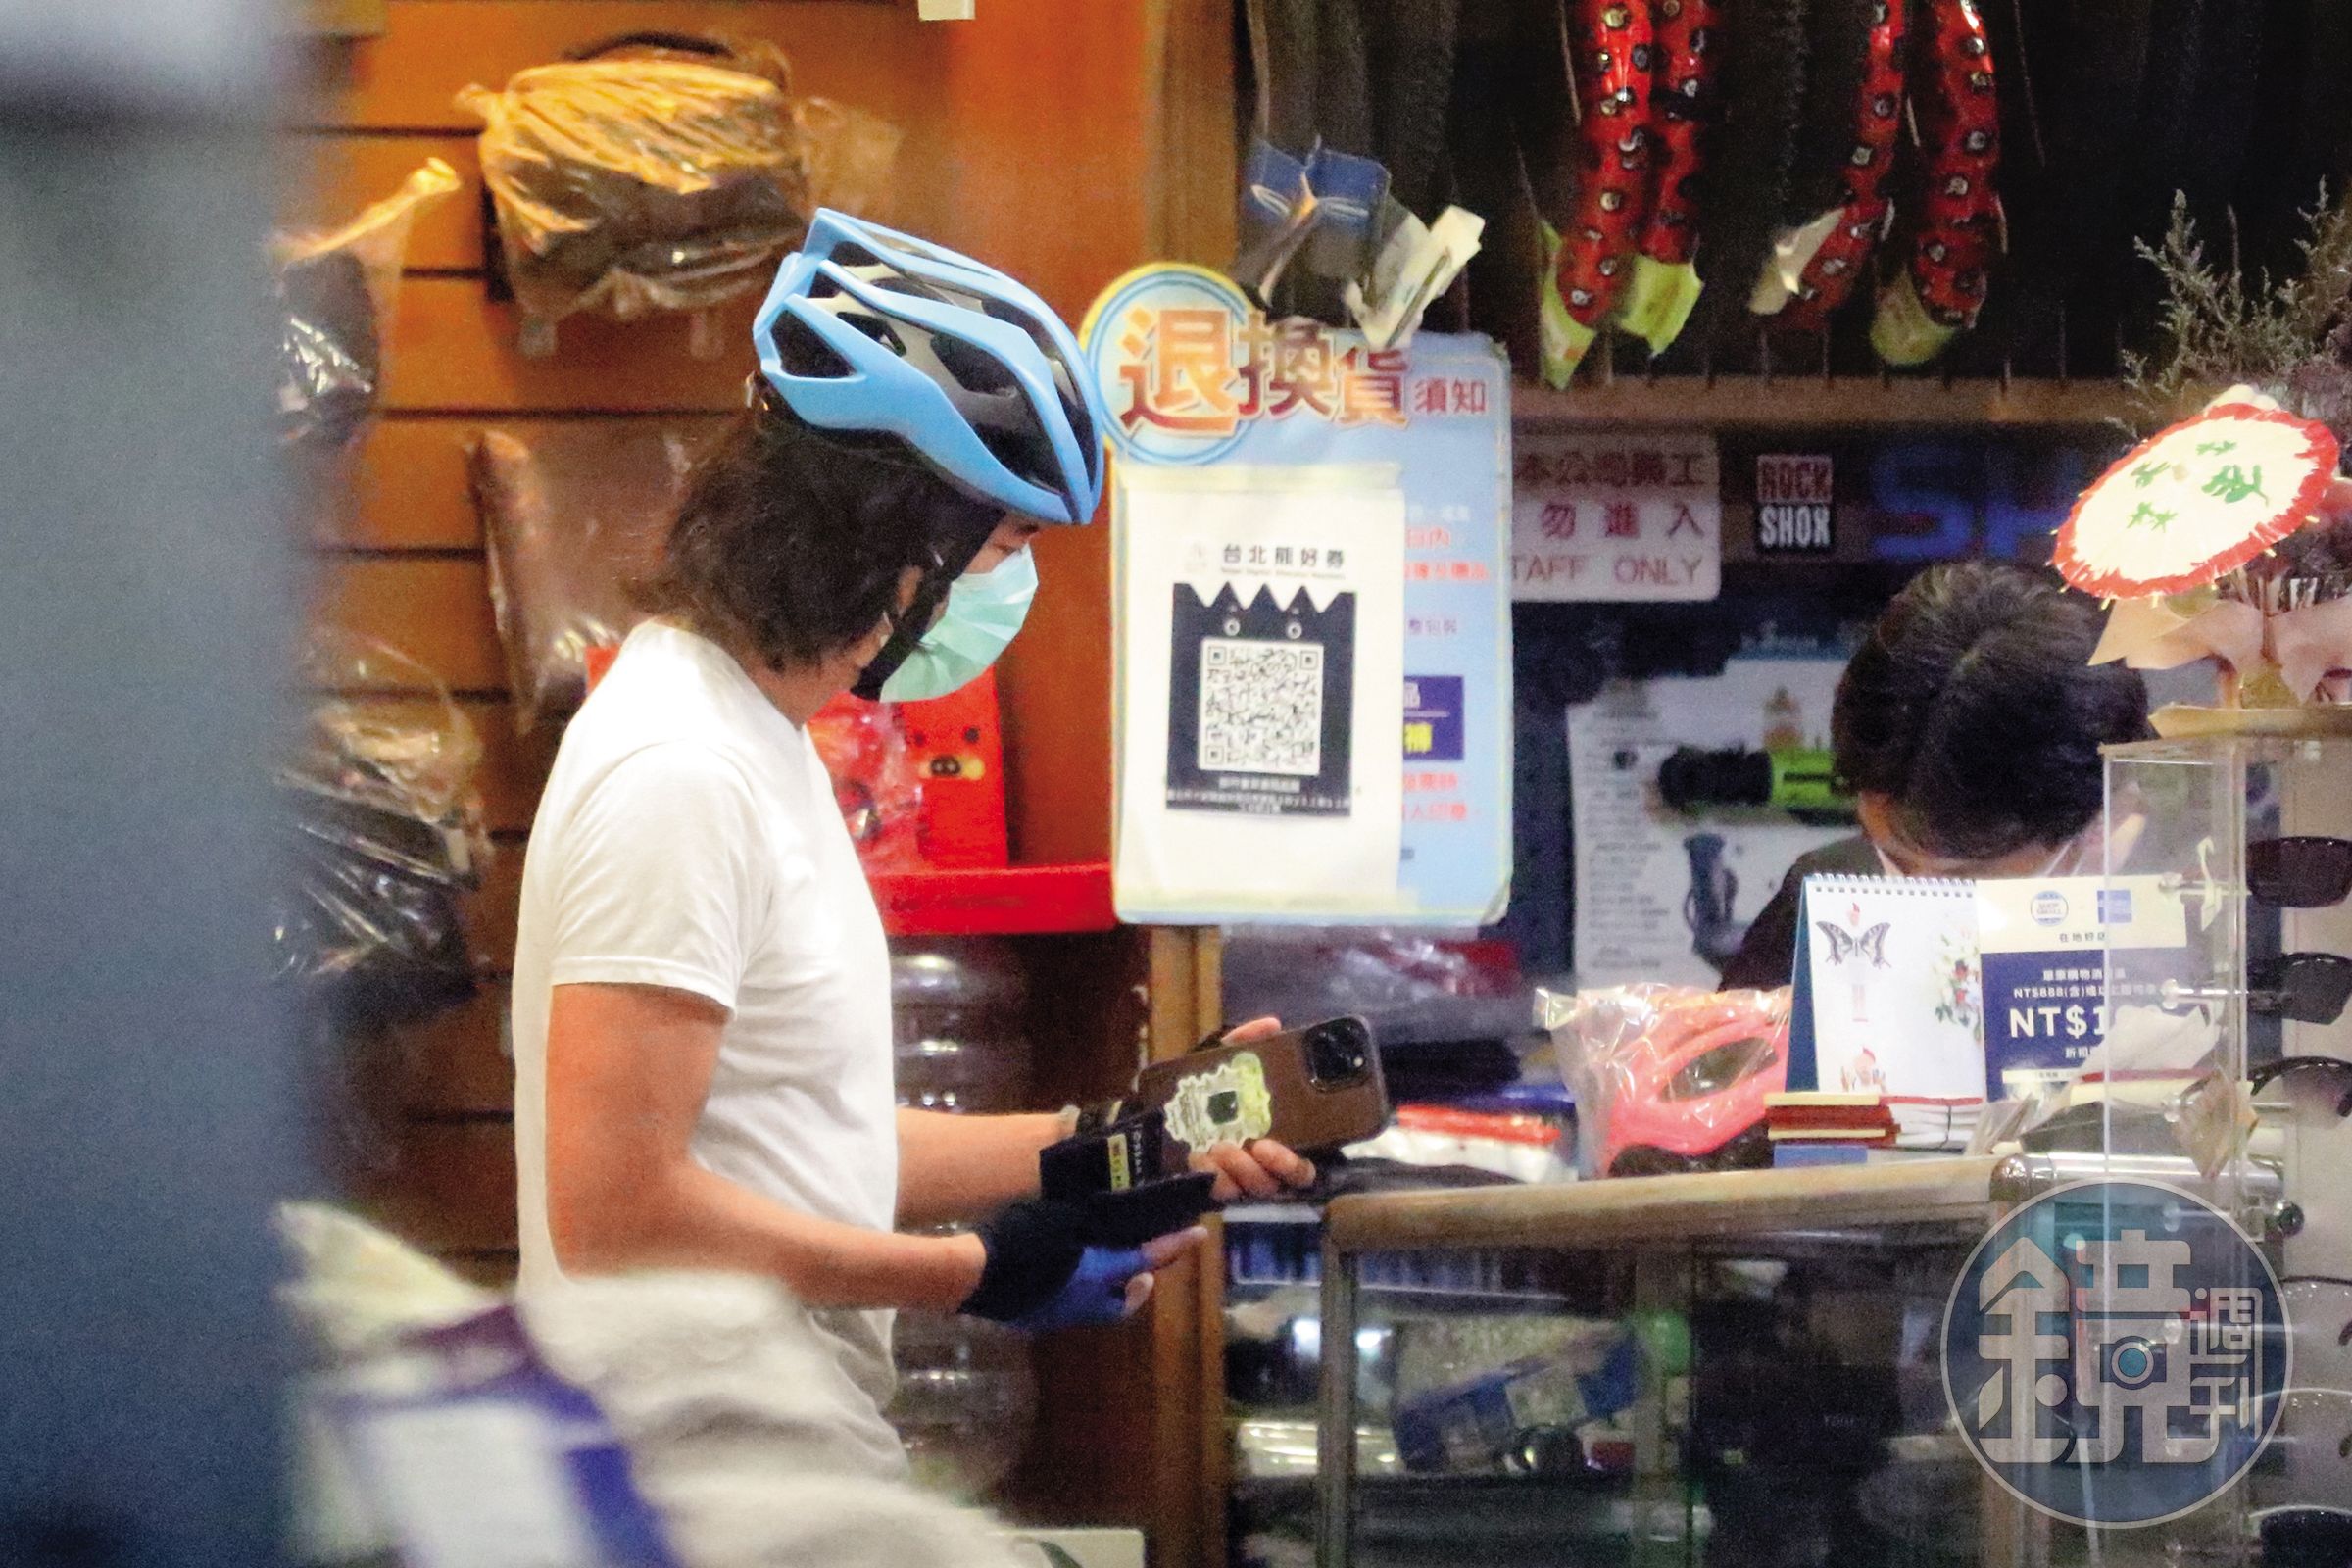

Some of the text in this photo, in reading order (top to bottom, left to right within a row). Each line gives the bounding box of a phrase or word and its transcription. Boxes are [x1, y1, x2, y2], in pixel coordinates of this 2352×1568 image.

[1763, 462, 1827, 499] ROCK
[1512, 553, 1589, 581] TAFF
[1614, 555, 1702, 585] ONLY
